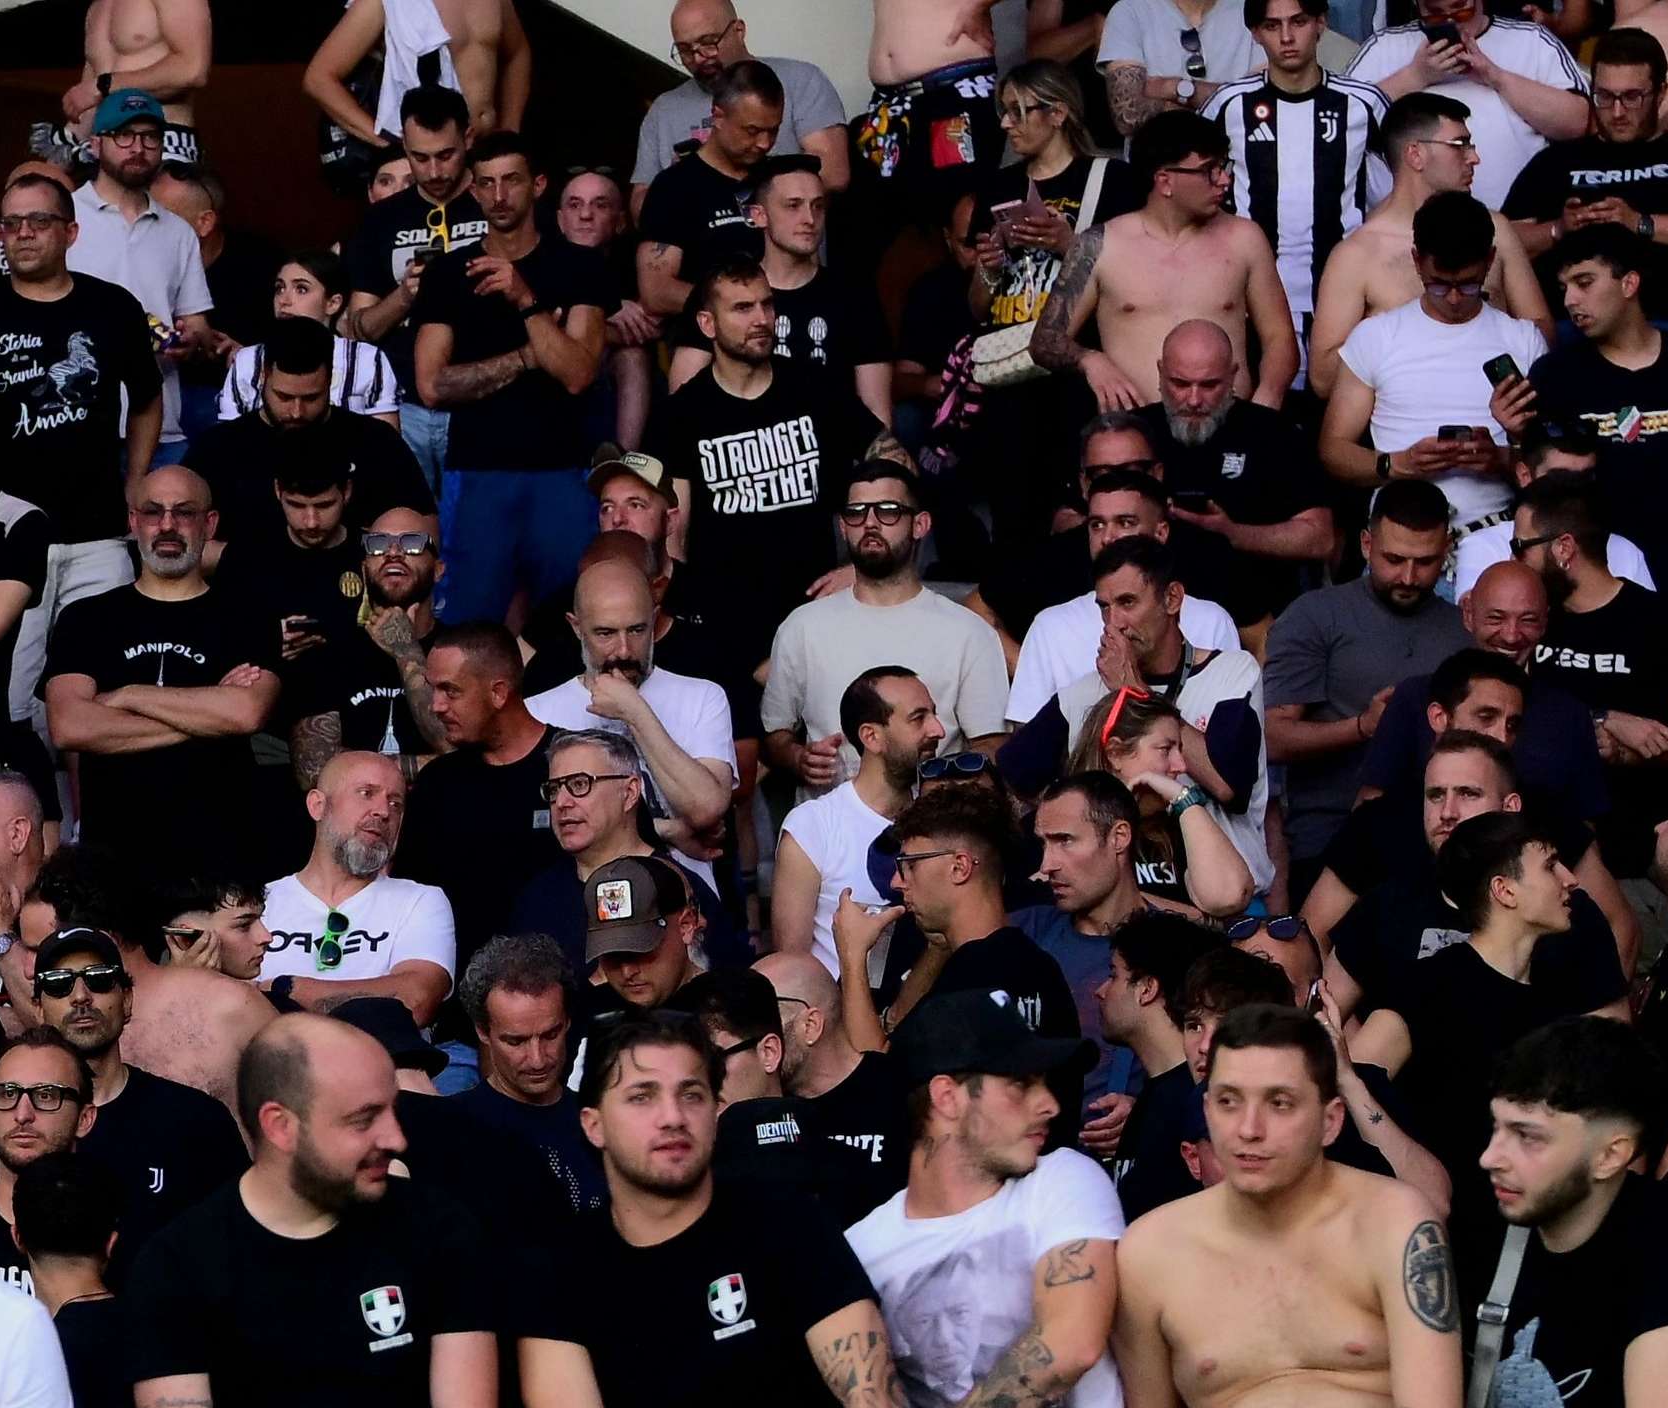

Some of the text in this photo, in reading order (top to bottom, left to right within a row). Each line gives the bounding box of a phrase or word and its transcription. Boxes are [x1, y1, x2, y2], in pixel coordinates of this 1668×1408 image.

[12, 402, 88, 439] Amore
[698, 414, 820, 484] STRONGER
[124, 643, 205, 664] MANIPOLO
[349, 687, 407, 707] MANIP
